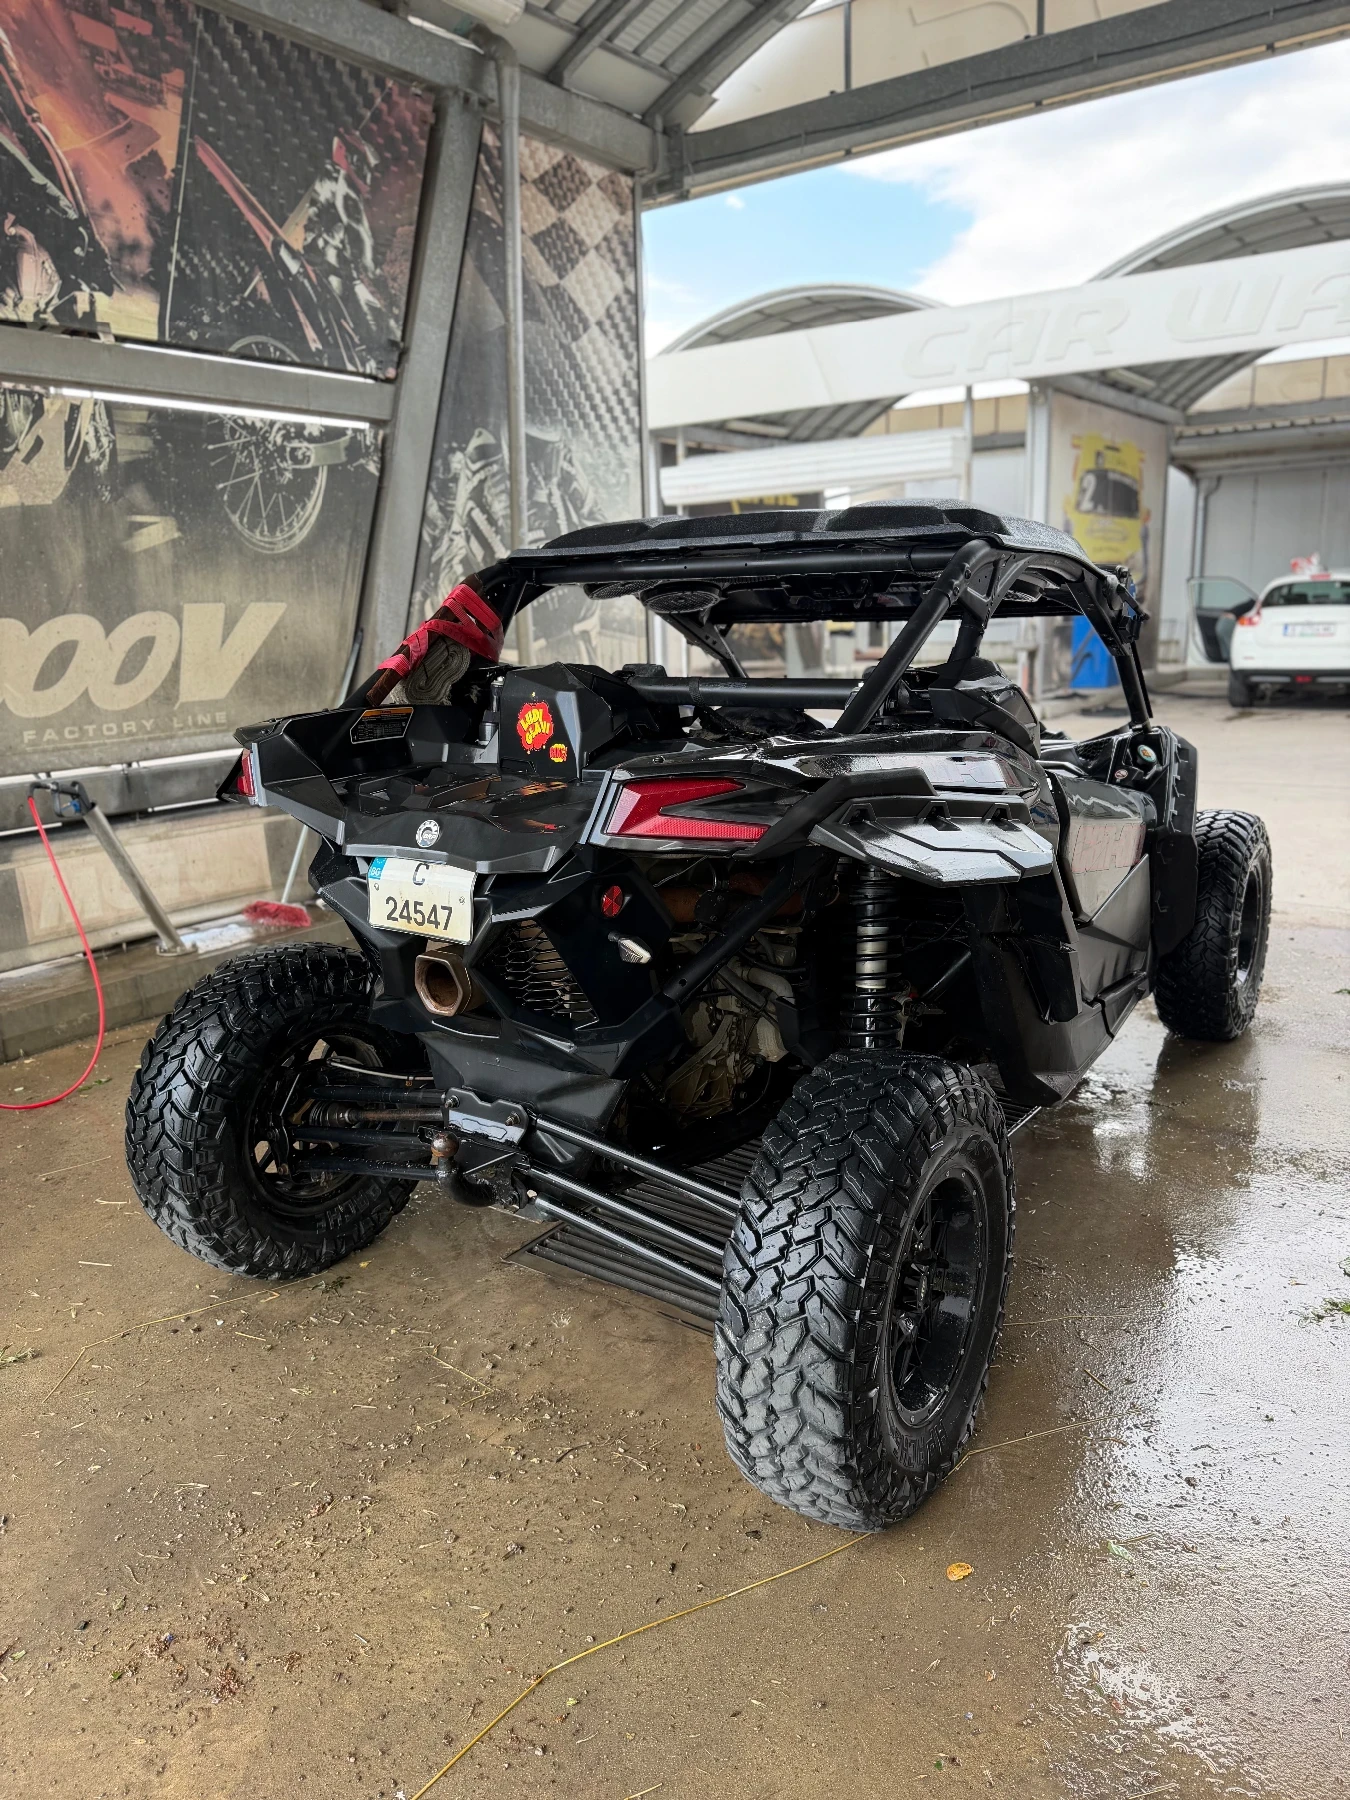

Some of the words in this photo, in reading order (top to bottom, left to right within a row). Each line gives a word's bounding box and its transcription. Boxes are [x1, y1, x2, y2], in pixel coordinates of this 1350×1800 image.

[902, 296, 1130, 380] CAR
[23, 718, 155, 744] FACTORY
[173, 711, 228, 729] LINE
[370, 866, 381, 876] BG
[412, 863, 430, 886] C
[385, 896, 453, 931] 24547
